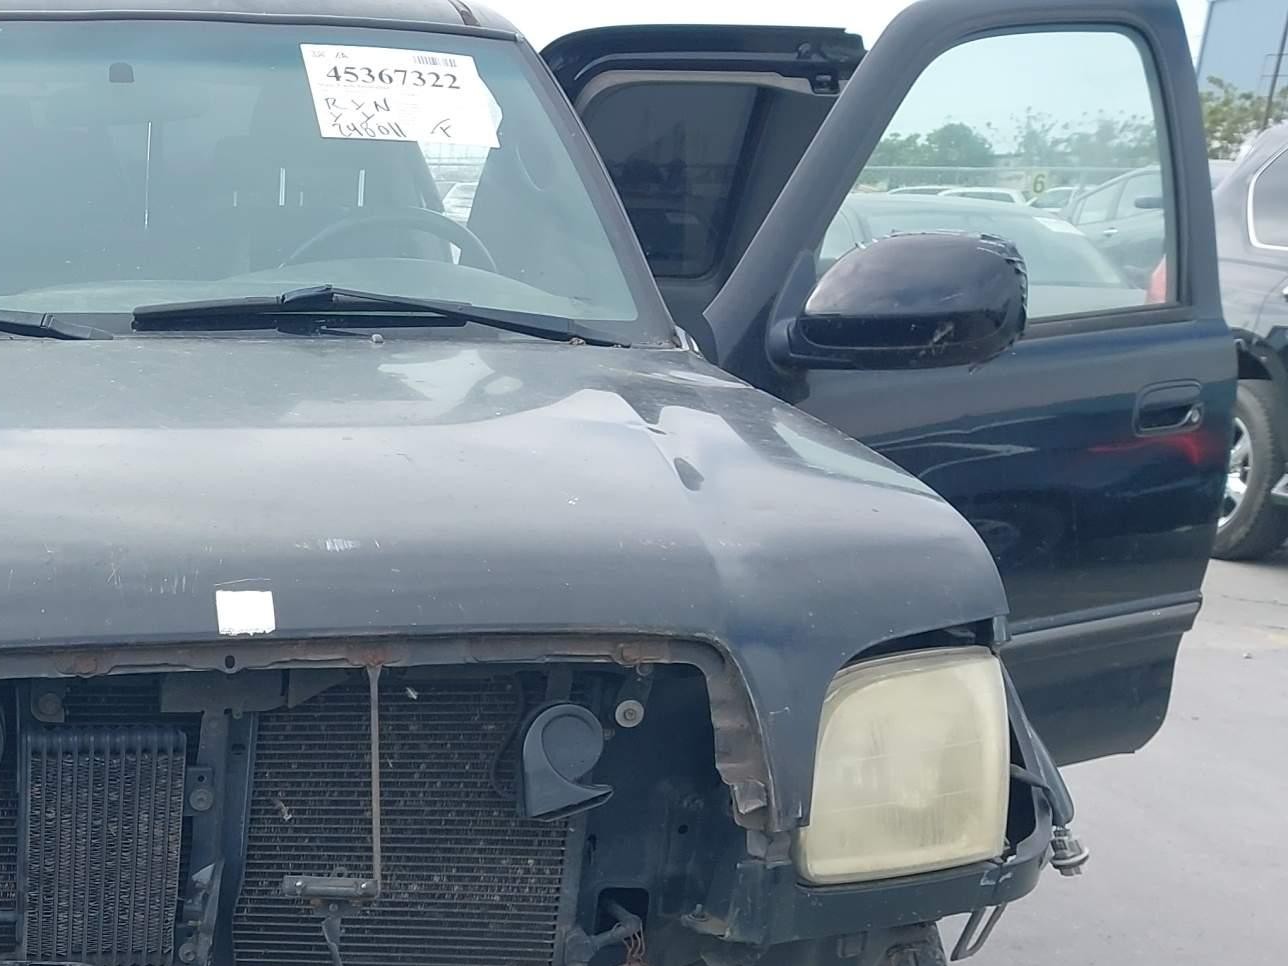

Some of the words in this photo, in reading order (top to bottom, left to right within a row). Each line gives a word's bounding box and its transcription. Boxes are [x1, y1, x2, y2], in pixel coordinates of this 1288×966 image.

[326, 66, 461, 89] 45367322
[373, 97, 390, 112] N
[1033, 174, 1045, 193] 6
